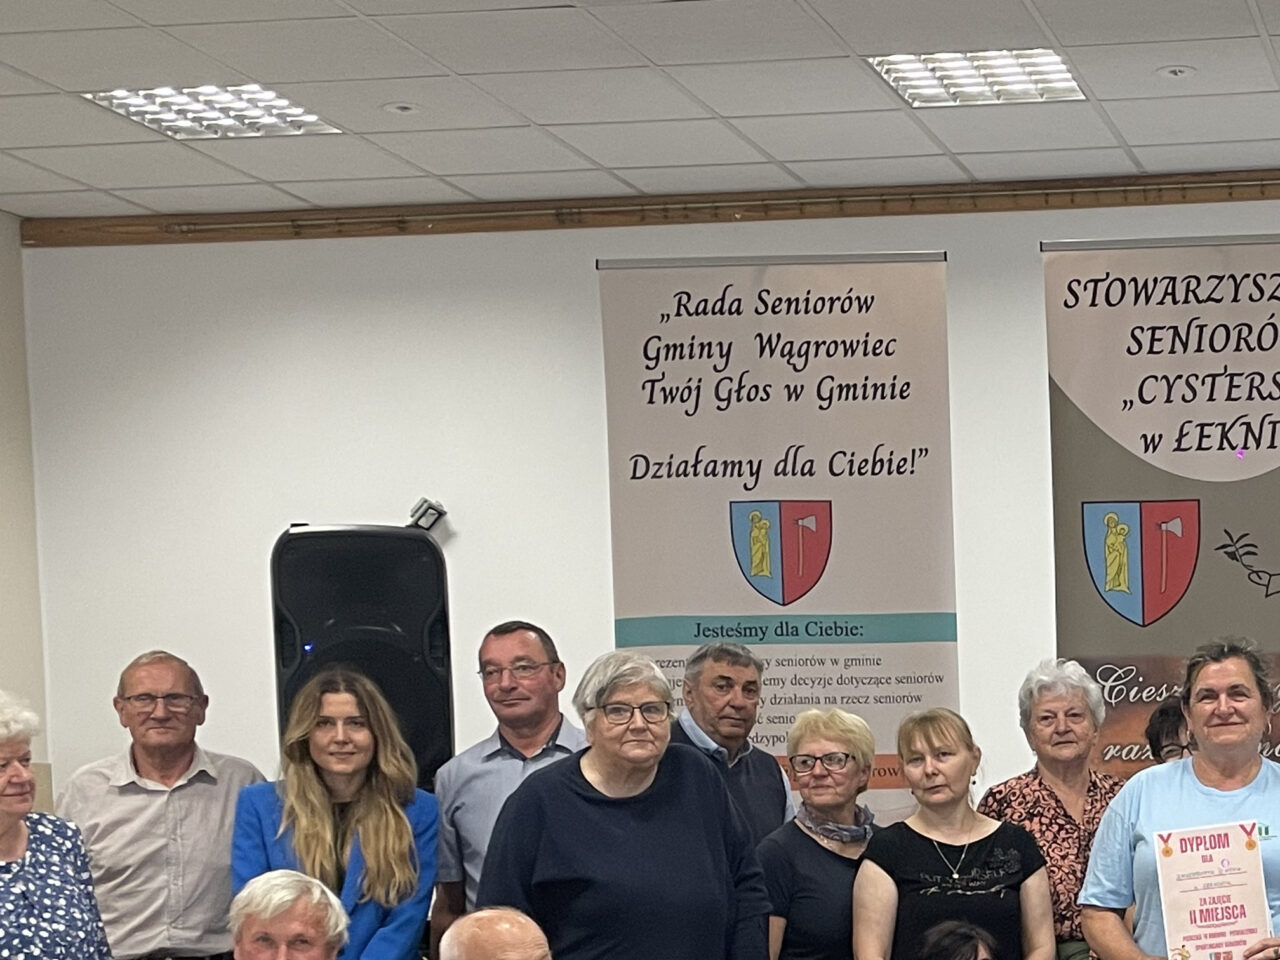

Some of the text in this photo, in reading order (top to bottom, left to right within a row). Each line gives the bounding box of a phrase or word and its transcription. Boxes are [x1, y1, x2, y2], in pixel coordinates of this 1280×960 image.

[660, 284, 875, 323] „Rada Seniorów
[642, 332, 897, 373] Gminy Wągrowiec
[641, 370, 911, 417] Twój Głos w Gminie
[1140, 432, 1163, 454] w
[629, 444, 929, 491] Działamy dla Ciebie!”
[694, 620, 864, 642] Jesteśmy dla Ciebie:
[775, 654, 826, 667] seniorów
[830, 657, 840, 667] w
[843, 655, 882, 670] gminie
[790, 673, 833, 689] decyzje
[836, 672, 892, 687] dotyczące
[894, 672, 944, 685] seniorów
[770, 693, 820, 705] działania
[824, 696, 837, 705] na
[840, 695, 870, 705] rzecz
[873, 692, 923, 704] seniorów
[1179, 833, 1230, 853] DYPLOM
[1189, 904, 1247, 925] II MIEJSCA
